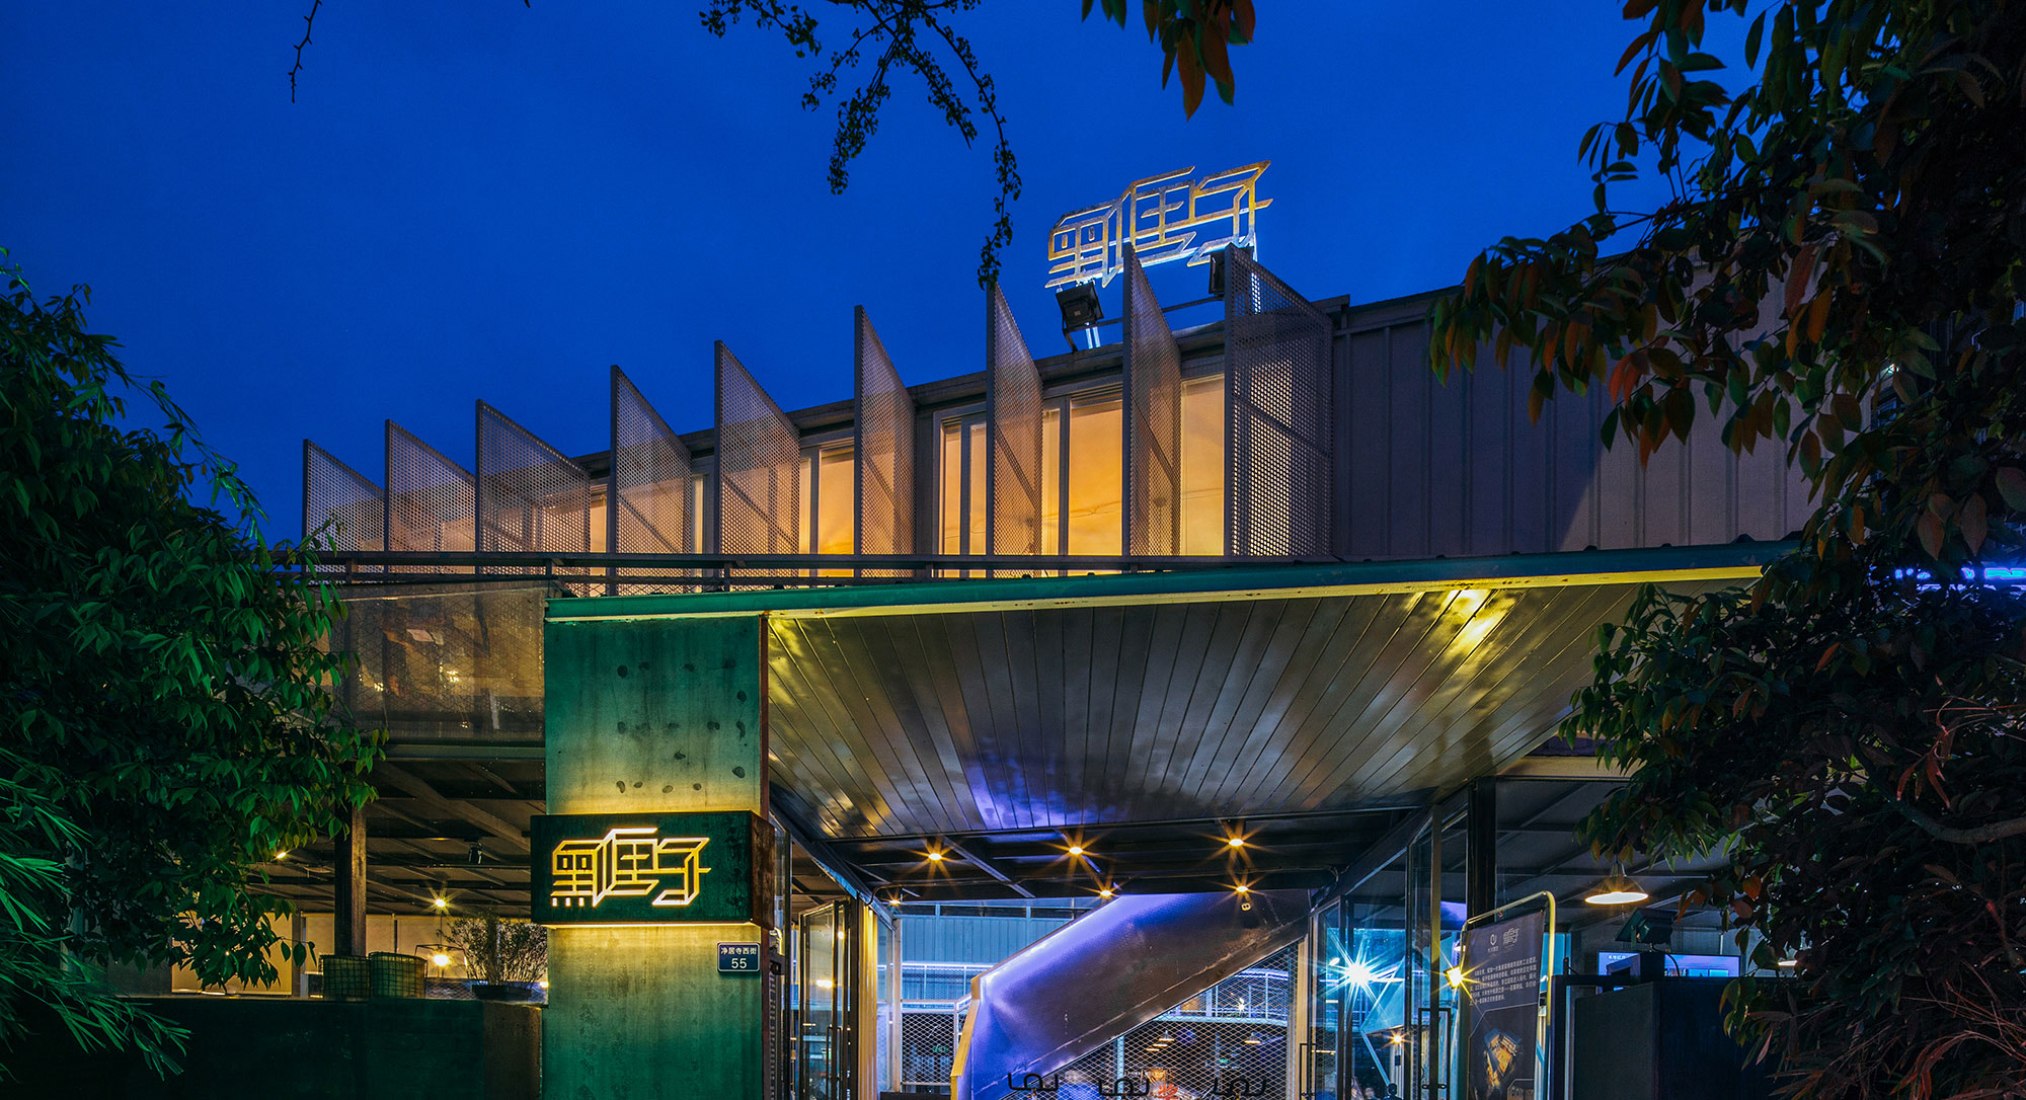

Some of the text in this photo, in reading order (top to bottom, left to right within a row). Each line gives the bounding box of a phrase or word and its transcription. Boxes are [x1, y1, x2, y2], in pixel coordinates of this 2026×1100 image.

[550, 827, 711, 907] 黑匣子
[731, 957, 748, 969] 55
